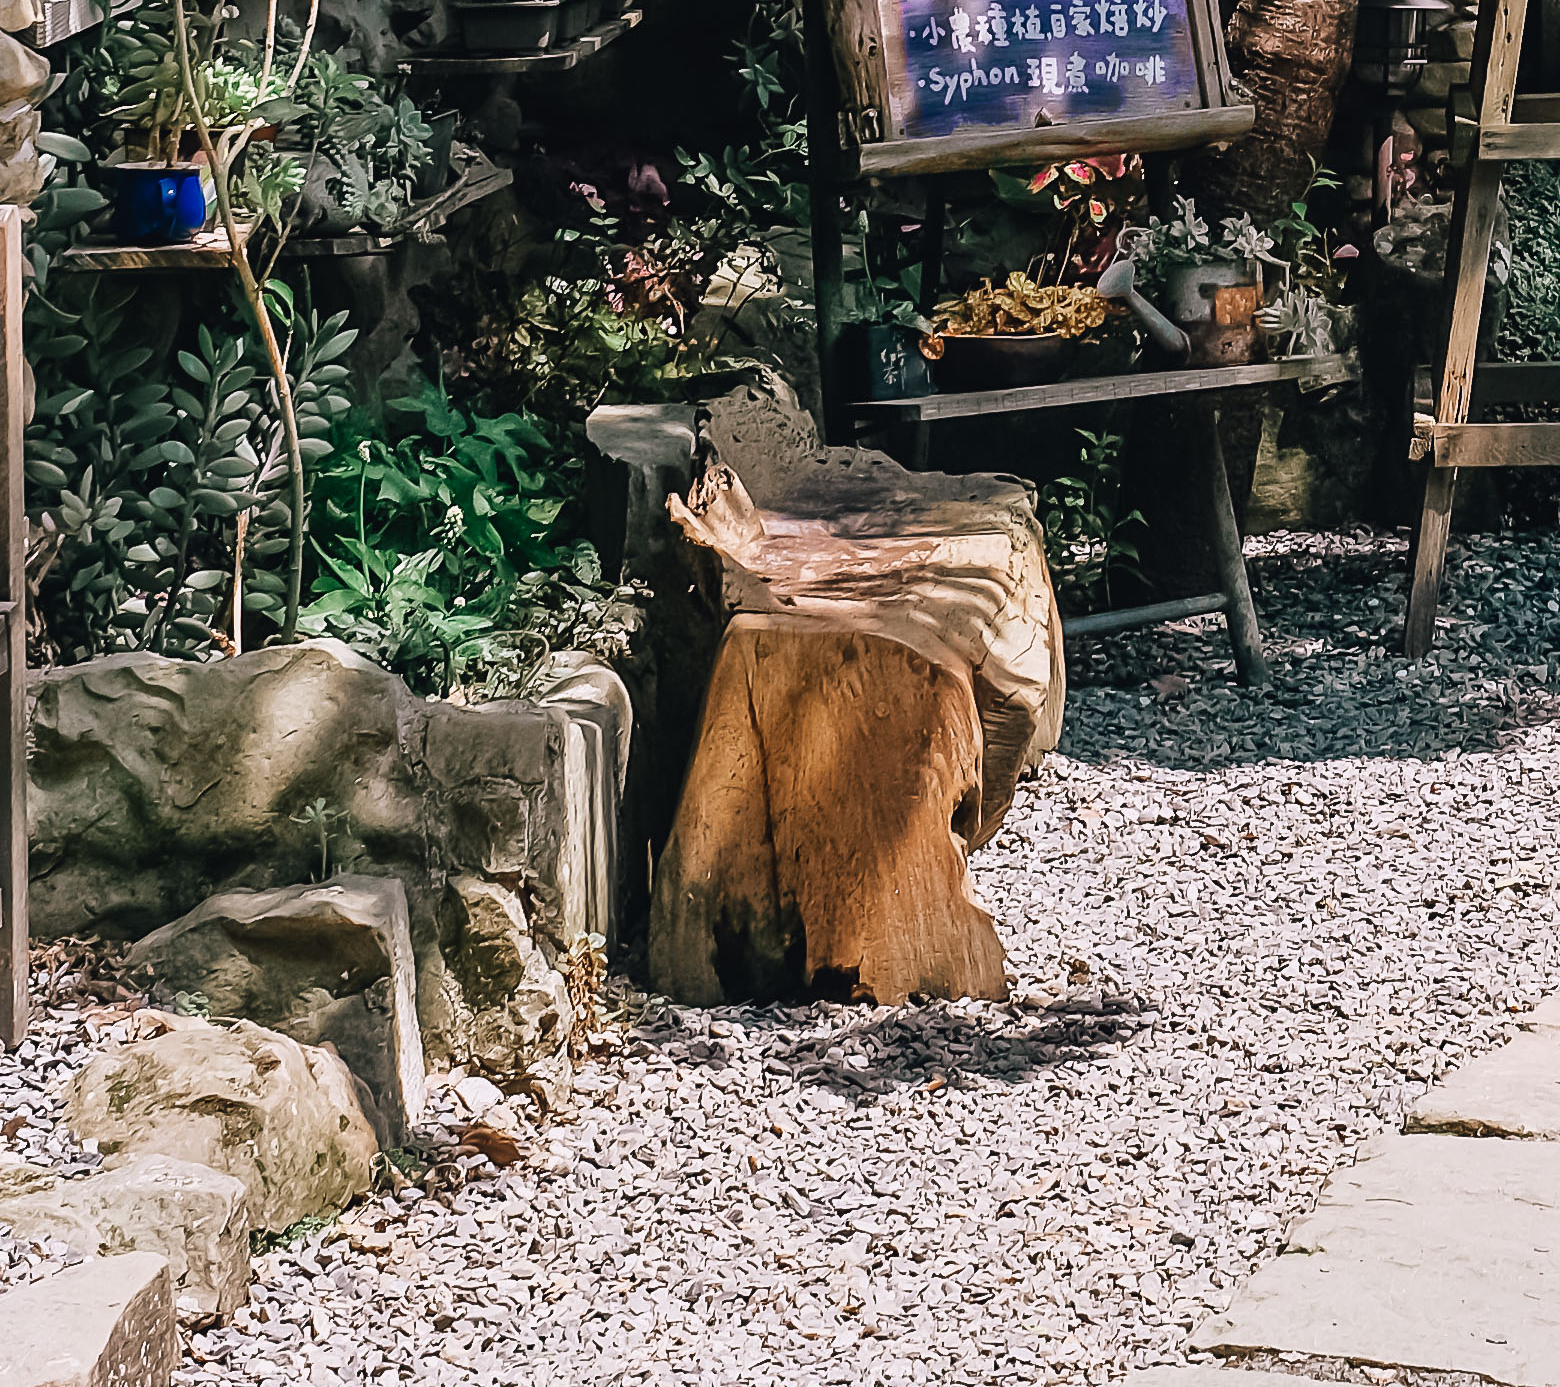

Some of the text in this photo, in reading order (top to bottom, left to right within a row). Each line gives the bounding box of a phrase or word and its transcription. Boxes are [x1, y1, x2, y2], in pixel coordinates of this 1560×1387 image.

[929, 50, 1168, 105] Syphon 現煮咖啡
